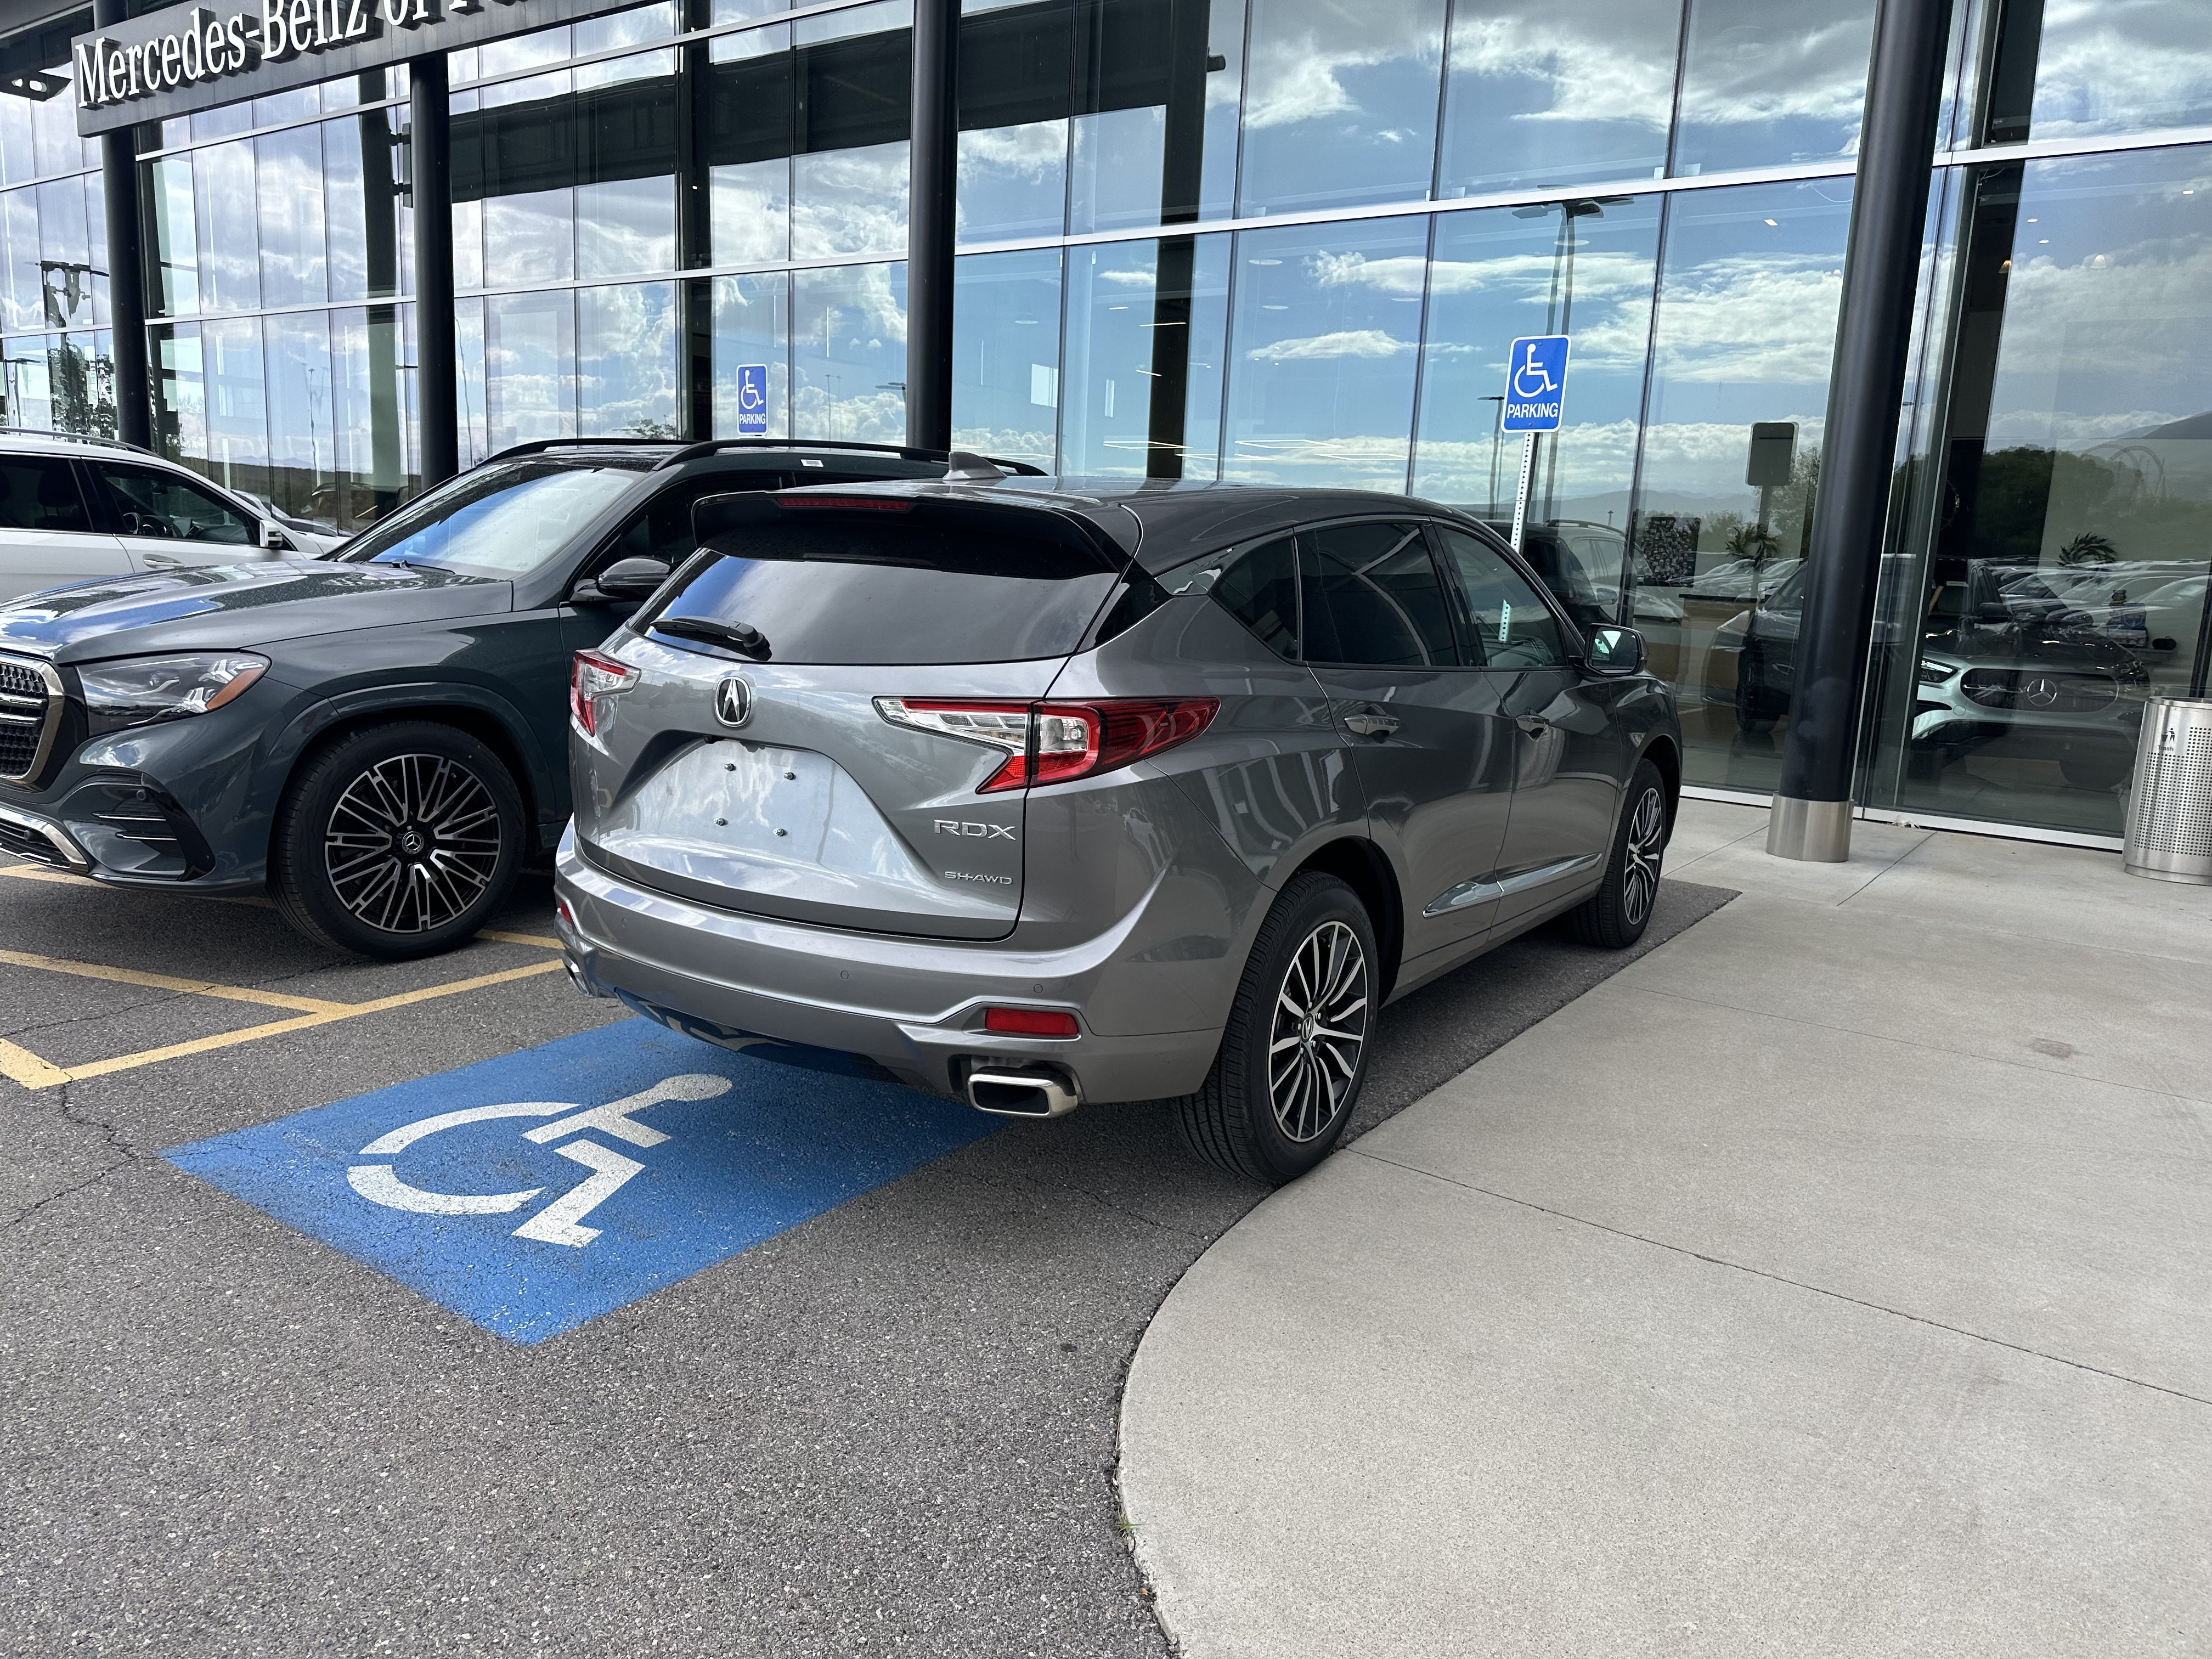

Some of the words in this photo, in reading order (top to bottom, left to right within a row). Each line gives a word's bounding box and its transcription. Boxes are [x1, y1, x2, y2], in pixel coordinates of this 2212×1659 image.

[75, 0, 368, 108] Mercedes-Benz
[1506, 402, 1559, 418] PARKING
[739, 413, 766, 424] PARKING
[934, 820, 1016, 840] RDX
[944, 871, 1012, 884] SH-AWD
